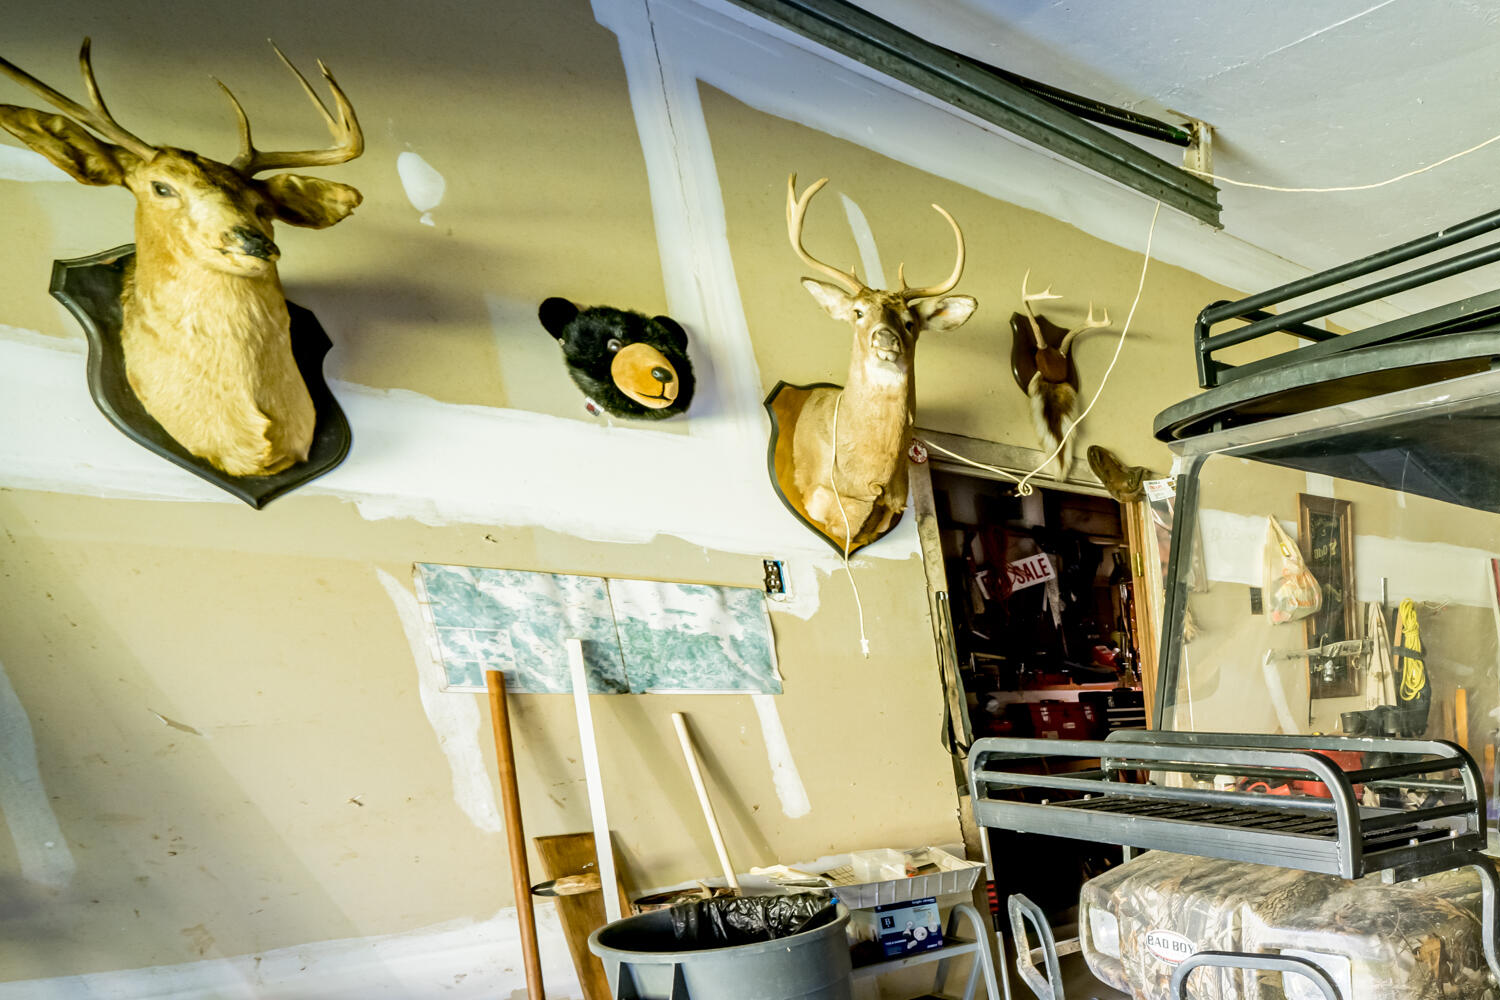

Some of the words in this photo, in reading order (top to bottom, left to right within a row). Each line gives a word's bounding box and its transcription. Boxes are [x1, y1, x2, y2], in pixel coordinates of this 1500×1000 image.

[1012, 557, 1051, 585] SALE
[1147, 935, 1169, 949] BAD
[1172, 940, 1195, 955] BOY
